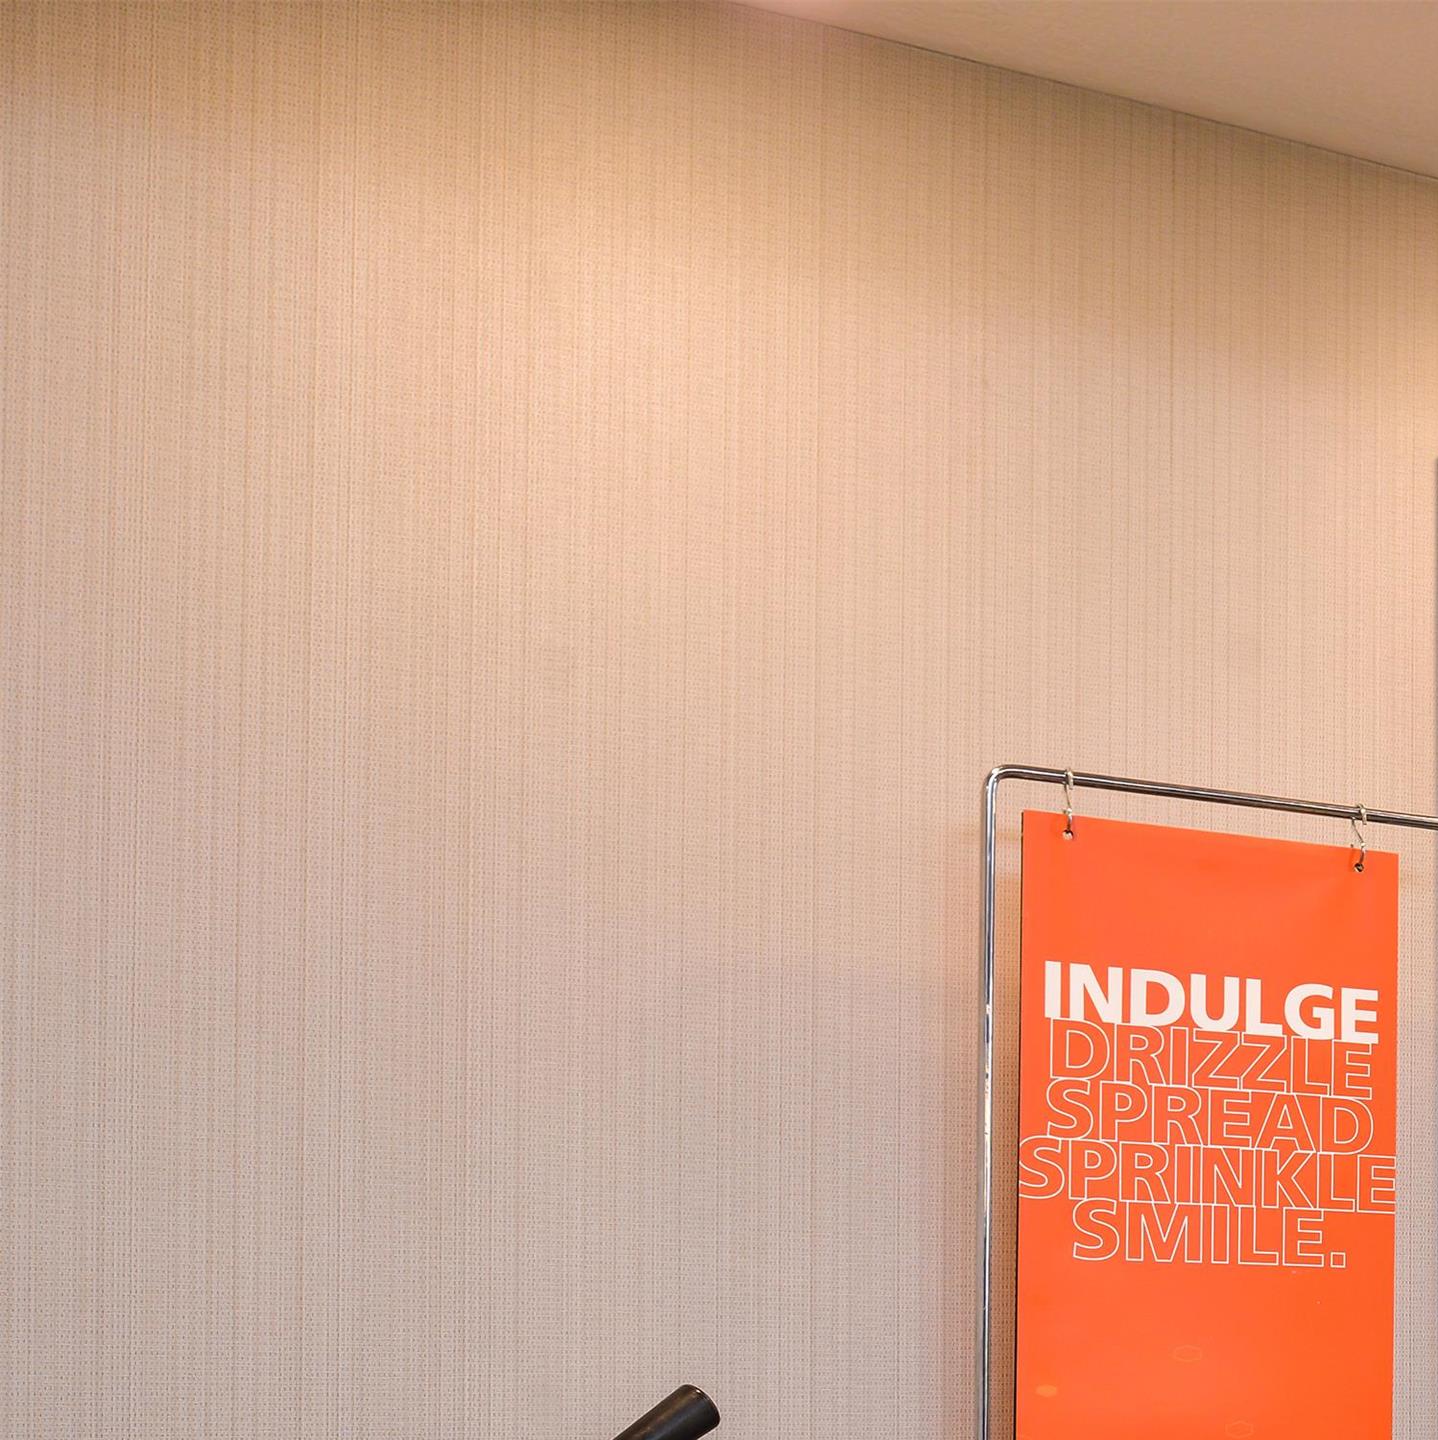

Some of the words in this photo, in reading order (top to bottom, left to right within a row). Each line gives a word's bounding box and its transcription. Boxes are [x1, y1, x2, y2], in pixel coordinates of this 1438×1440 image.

[1044, 960, 1379, 1044] INDULGE
[1049, 1018, 1373, 1099] DRIZZLE
[1046, 1078, 1374, 1155] SPREAD
[1019, 1135, 1395, 1214] SPRINKLE
[1072, 1197, 1347, 1269] SMILE.
